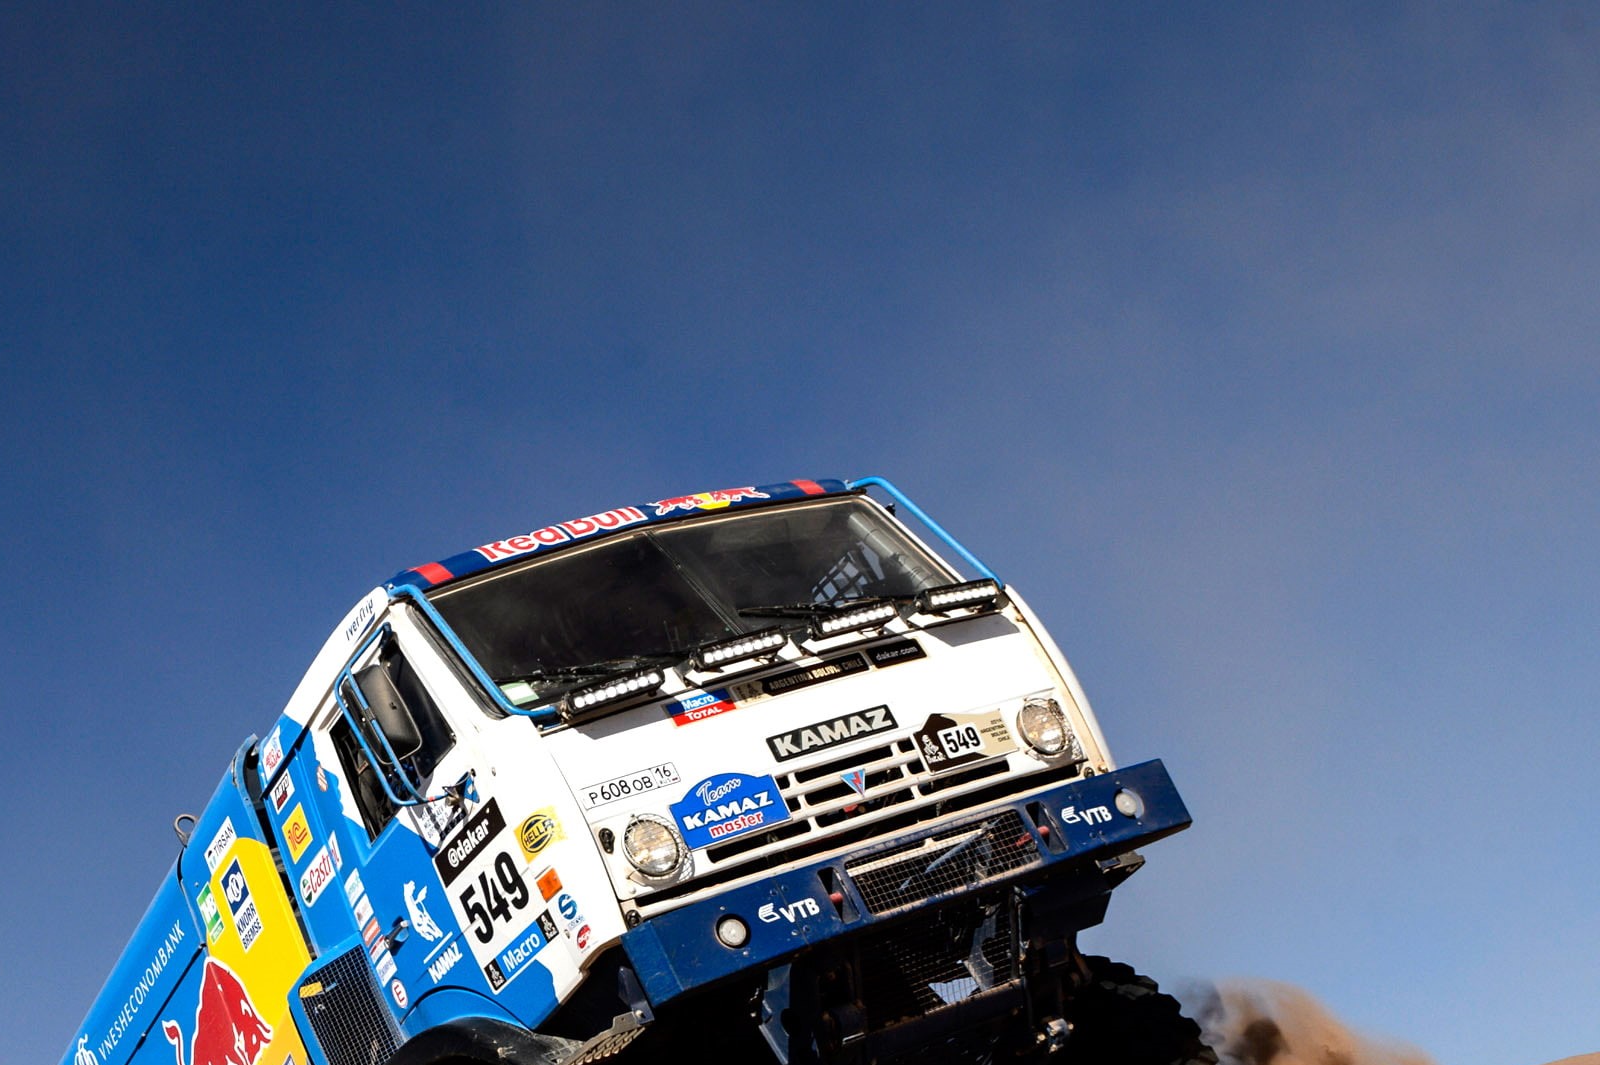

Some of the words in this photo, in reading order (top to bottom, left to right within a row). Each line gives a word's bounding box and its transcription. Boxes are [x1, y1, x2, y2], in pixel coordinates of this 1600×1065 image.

[875, 645, 919, 662] dakar.com
[683, 695, 715, 710] Macro
[685, 705, 723, 720] TOTAL
[773, 708, 893, 757] KAMAZ
[943, 726, 981, 753] 549
[654, 765, 672, 779] 16
[696, 778, 742, 806] Team
[682, 791, 774, 831] KAMAZ
[708, 811, 764, 839] master
[1080, 803, 1113, 827] VTB
[447, 818, 490, 868] @dakar
[459, 851, 530, 944] 549
[779, 897, 820, 924] VTB
[236, 901, 257, 935] KNORR
[242, 917, 262, 950] BREMSE
[427, 941, 463, 984] KAMAZ
[502, 933, 540, 973] Macro
[98, 919, 185, 1061] VNESHECONOMBANK
